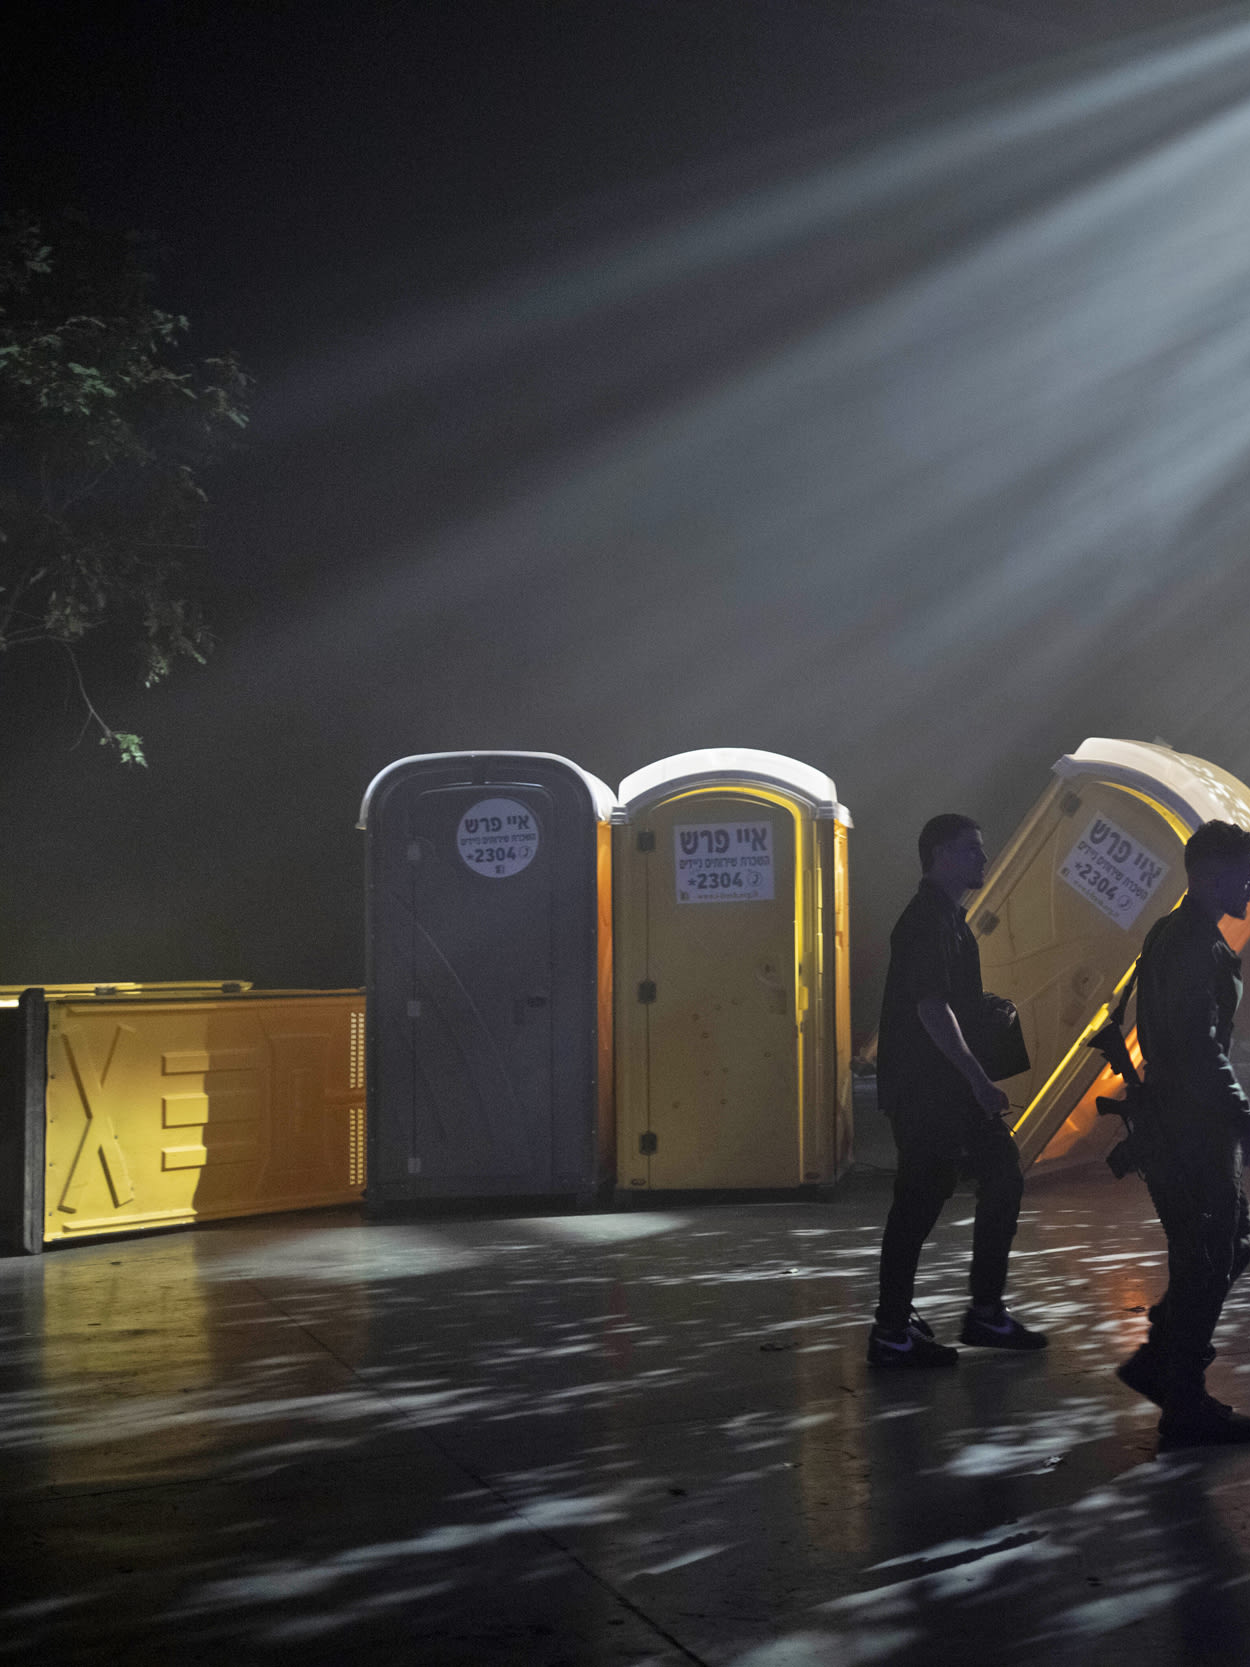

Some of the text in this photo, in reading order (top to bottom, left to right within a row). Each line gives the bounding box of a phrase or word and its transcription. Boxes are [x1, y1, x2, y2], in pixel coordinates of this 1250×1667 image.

[465, 815, 530, 834] איי פרש
[680, 827, 768, 855] איי פרש
[1090, 819, 1132, 863] פרש
